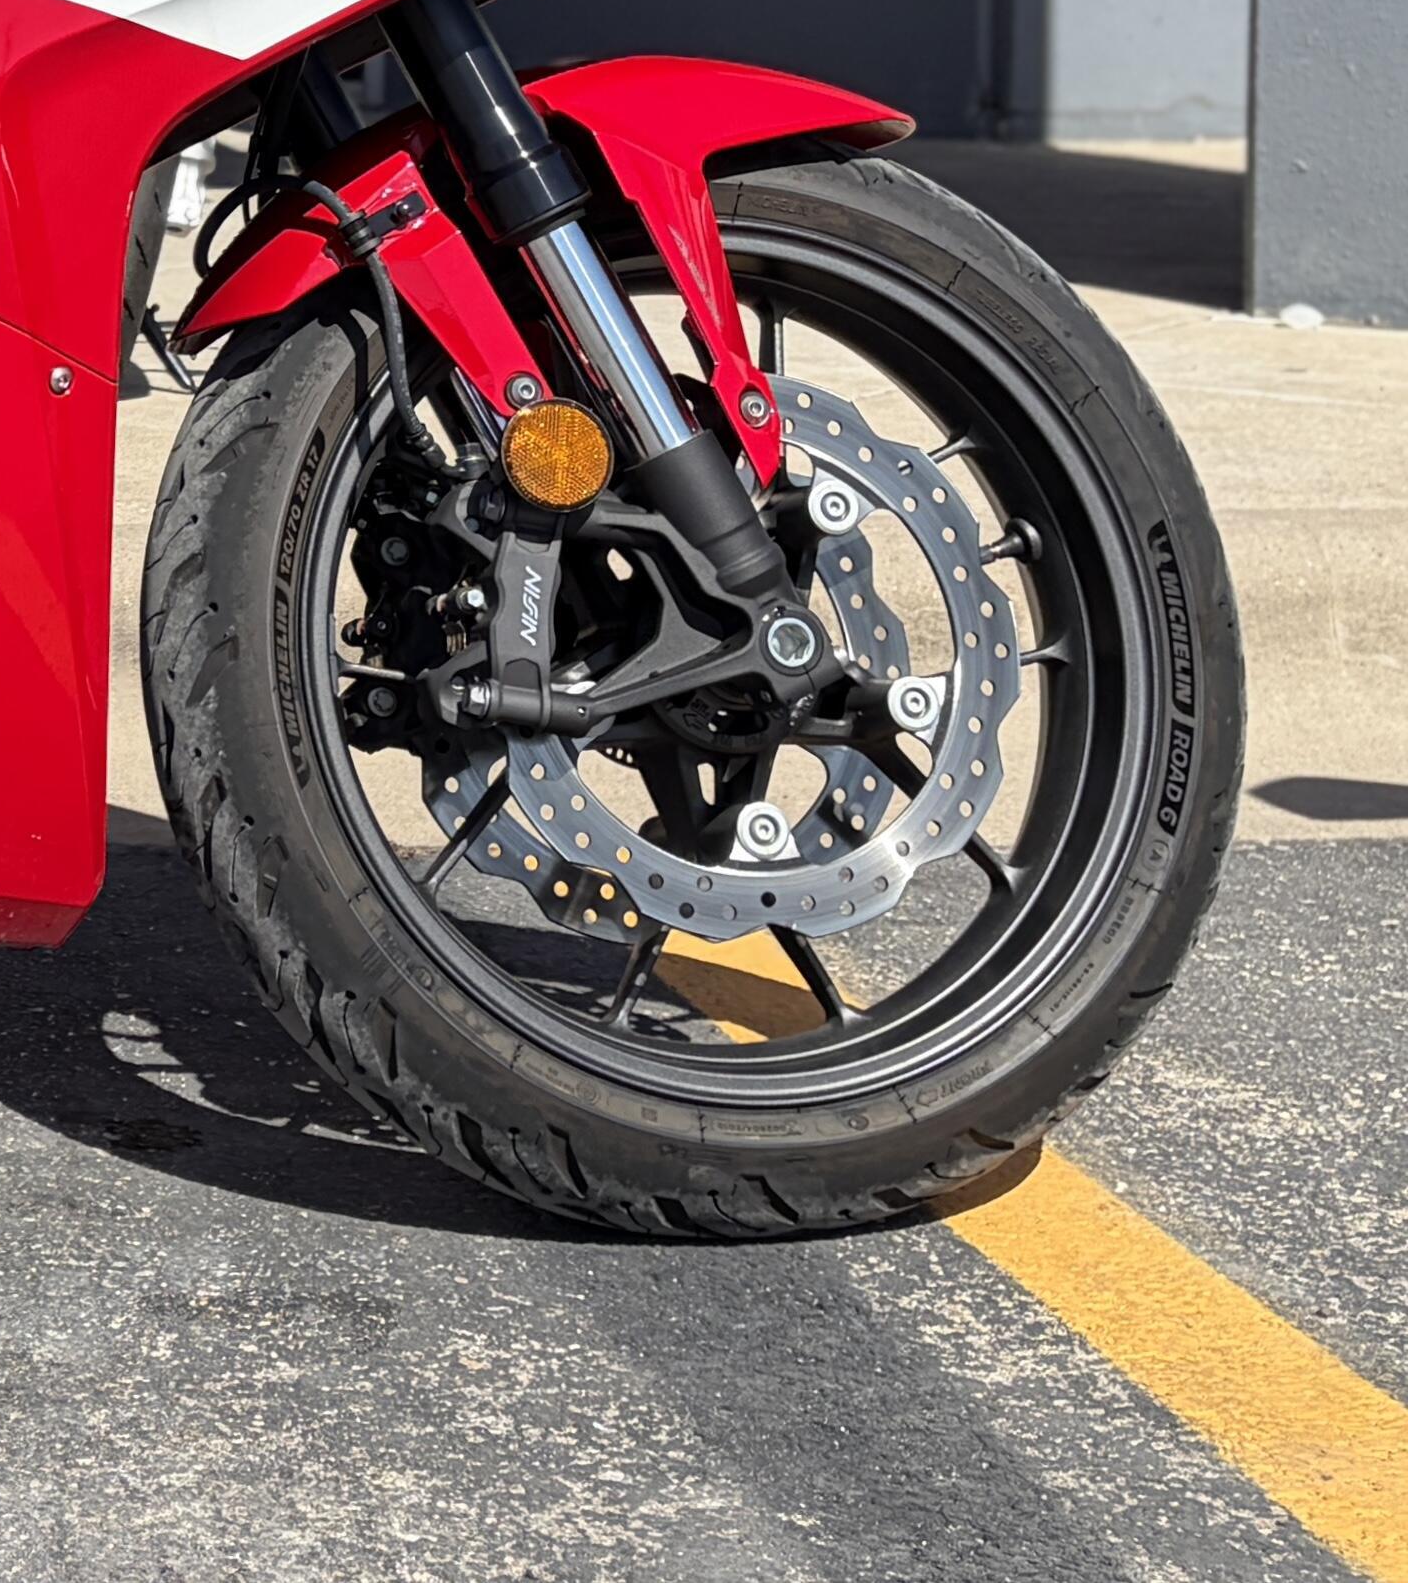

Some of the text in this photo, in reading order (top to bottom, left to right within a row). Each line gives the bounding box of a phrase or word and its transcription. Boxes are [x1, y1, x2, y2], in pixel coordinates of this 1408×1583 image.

[275, 445, 320, 737] MICHELIN 120/70 ZR 17
[1159, 570, 1192, 828] MICHELIN ROAD 6
